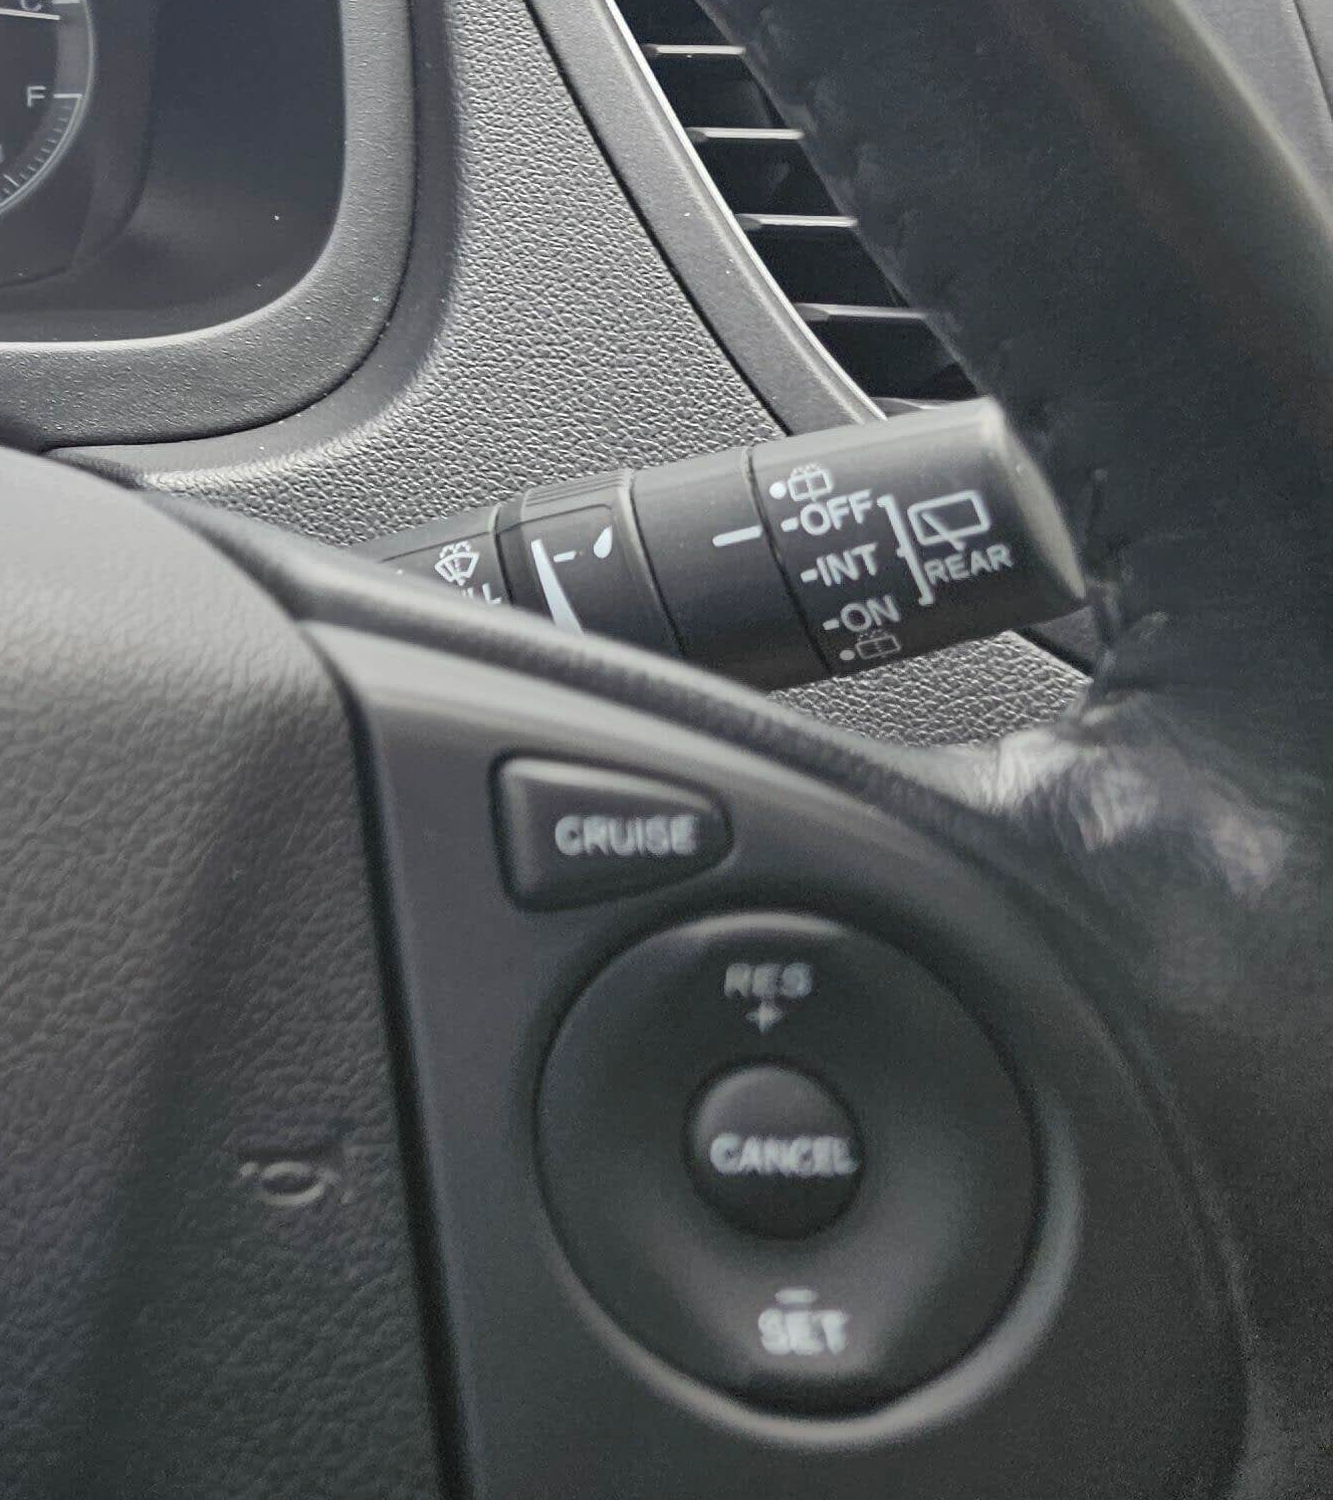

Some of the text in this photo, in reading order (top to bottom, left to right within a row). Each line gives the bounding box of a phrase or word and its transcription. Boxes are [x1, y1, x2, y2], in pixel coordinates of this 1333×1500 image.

[26, 85, 48, 107] F
[800, 489, 873, 536] OFF
[816, 542, 879, 587] INT
[923, 544, 1015, 586] REAR
[840, 595, 900, 632] ON
[555, 814, 700, 857] CRUISE
[709, 1132, 859, 1178] CANCEL
[757, 1307, 850, 1357] SET
